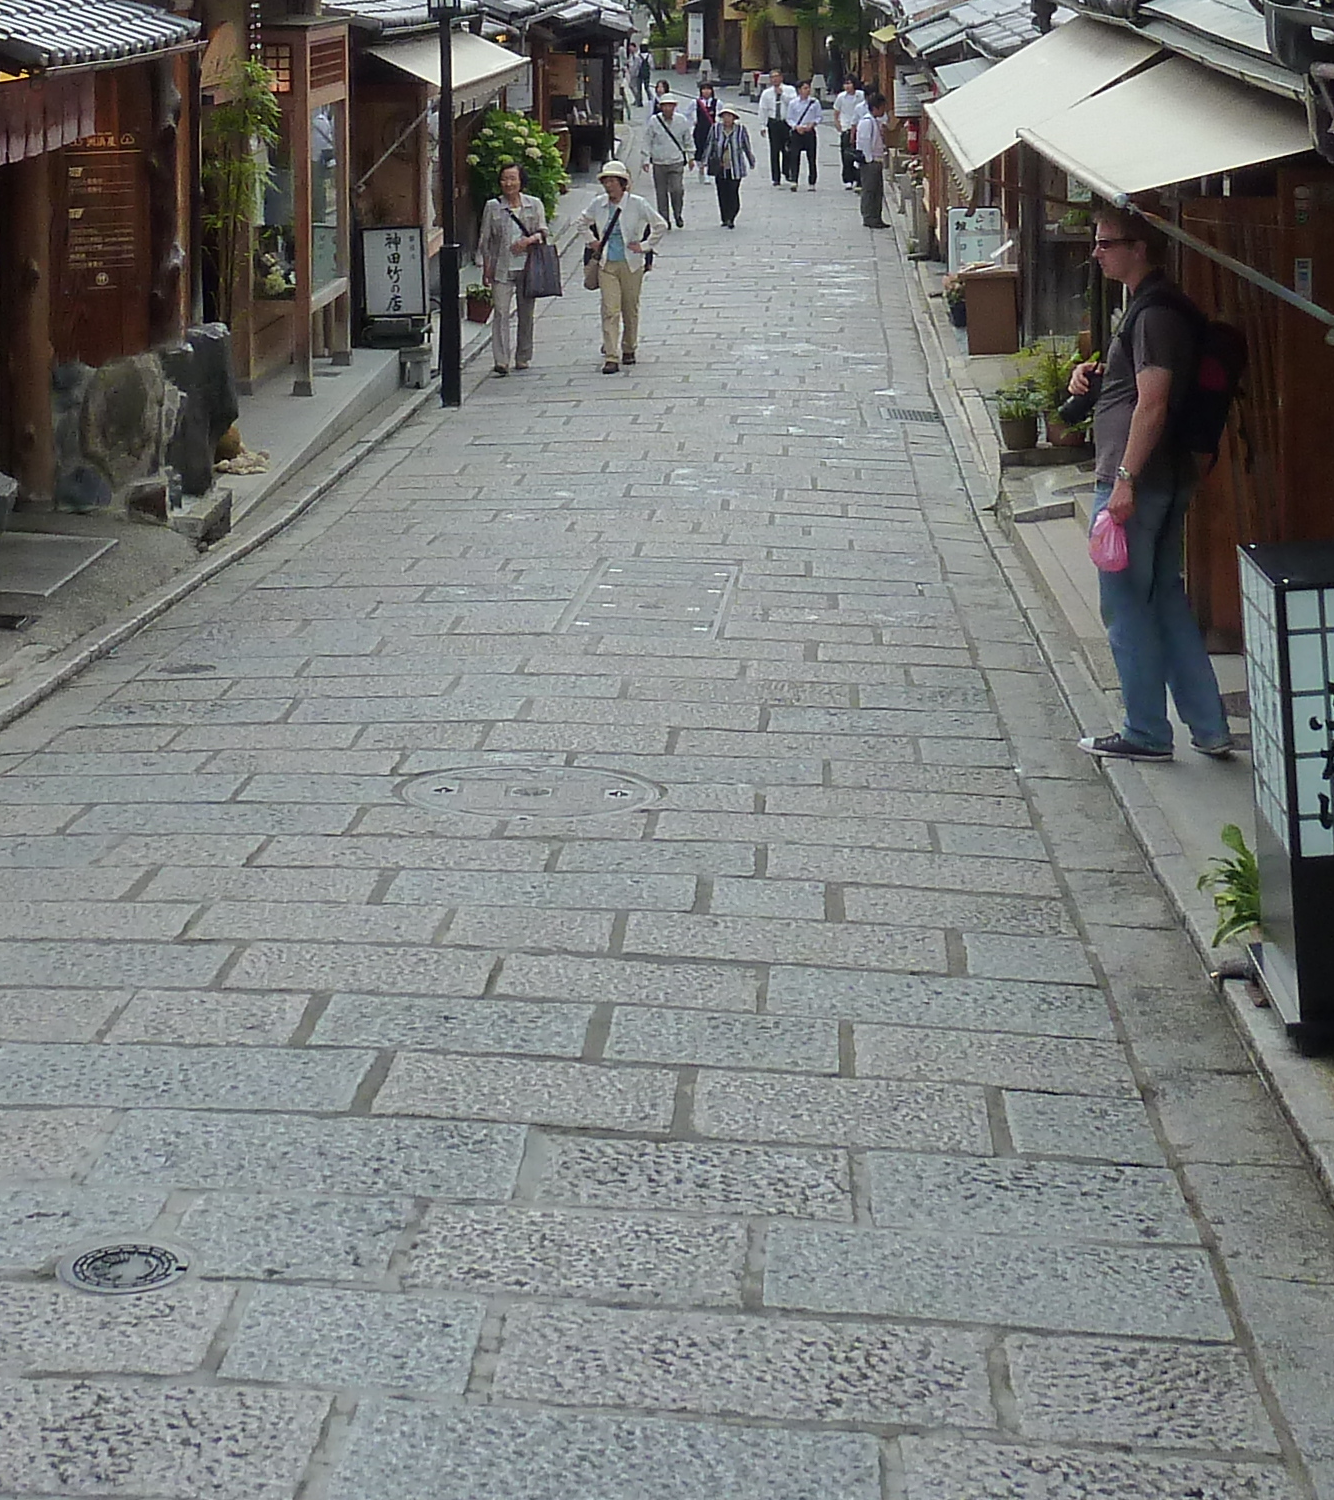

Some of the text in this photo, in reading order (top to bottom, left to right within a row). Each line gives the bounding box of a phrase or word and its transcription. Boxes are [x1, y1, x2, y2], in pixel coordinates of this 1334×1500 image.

[384, 231, 404, 312] 神田竹の店
